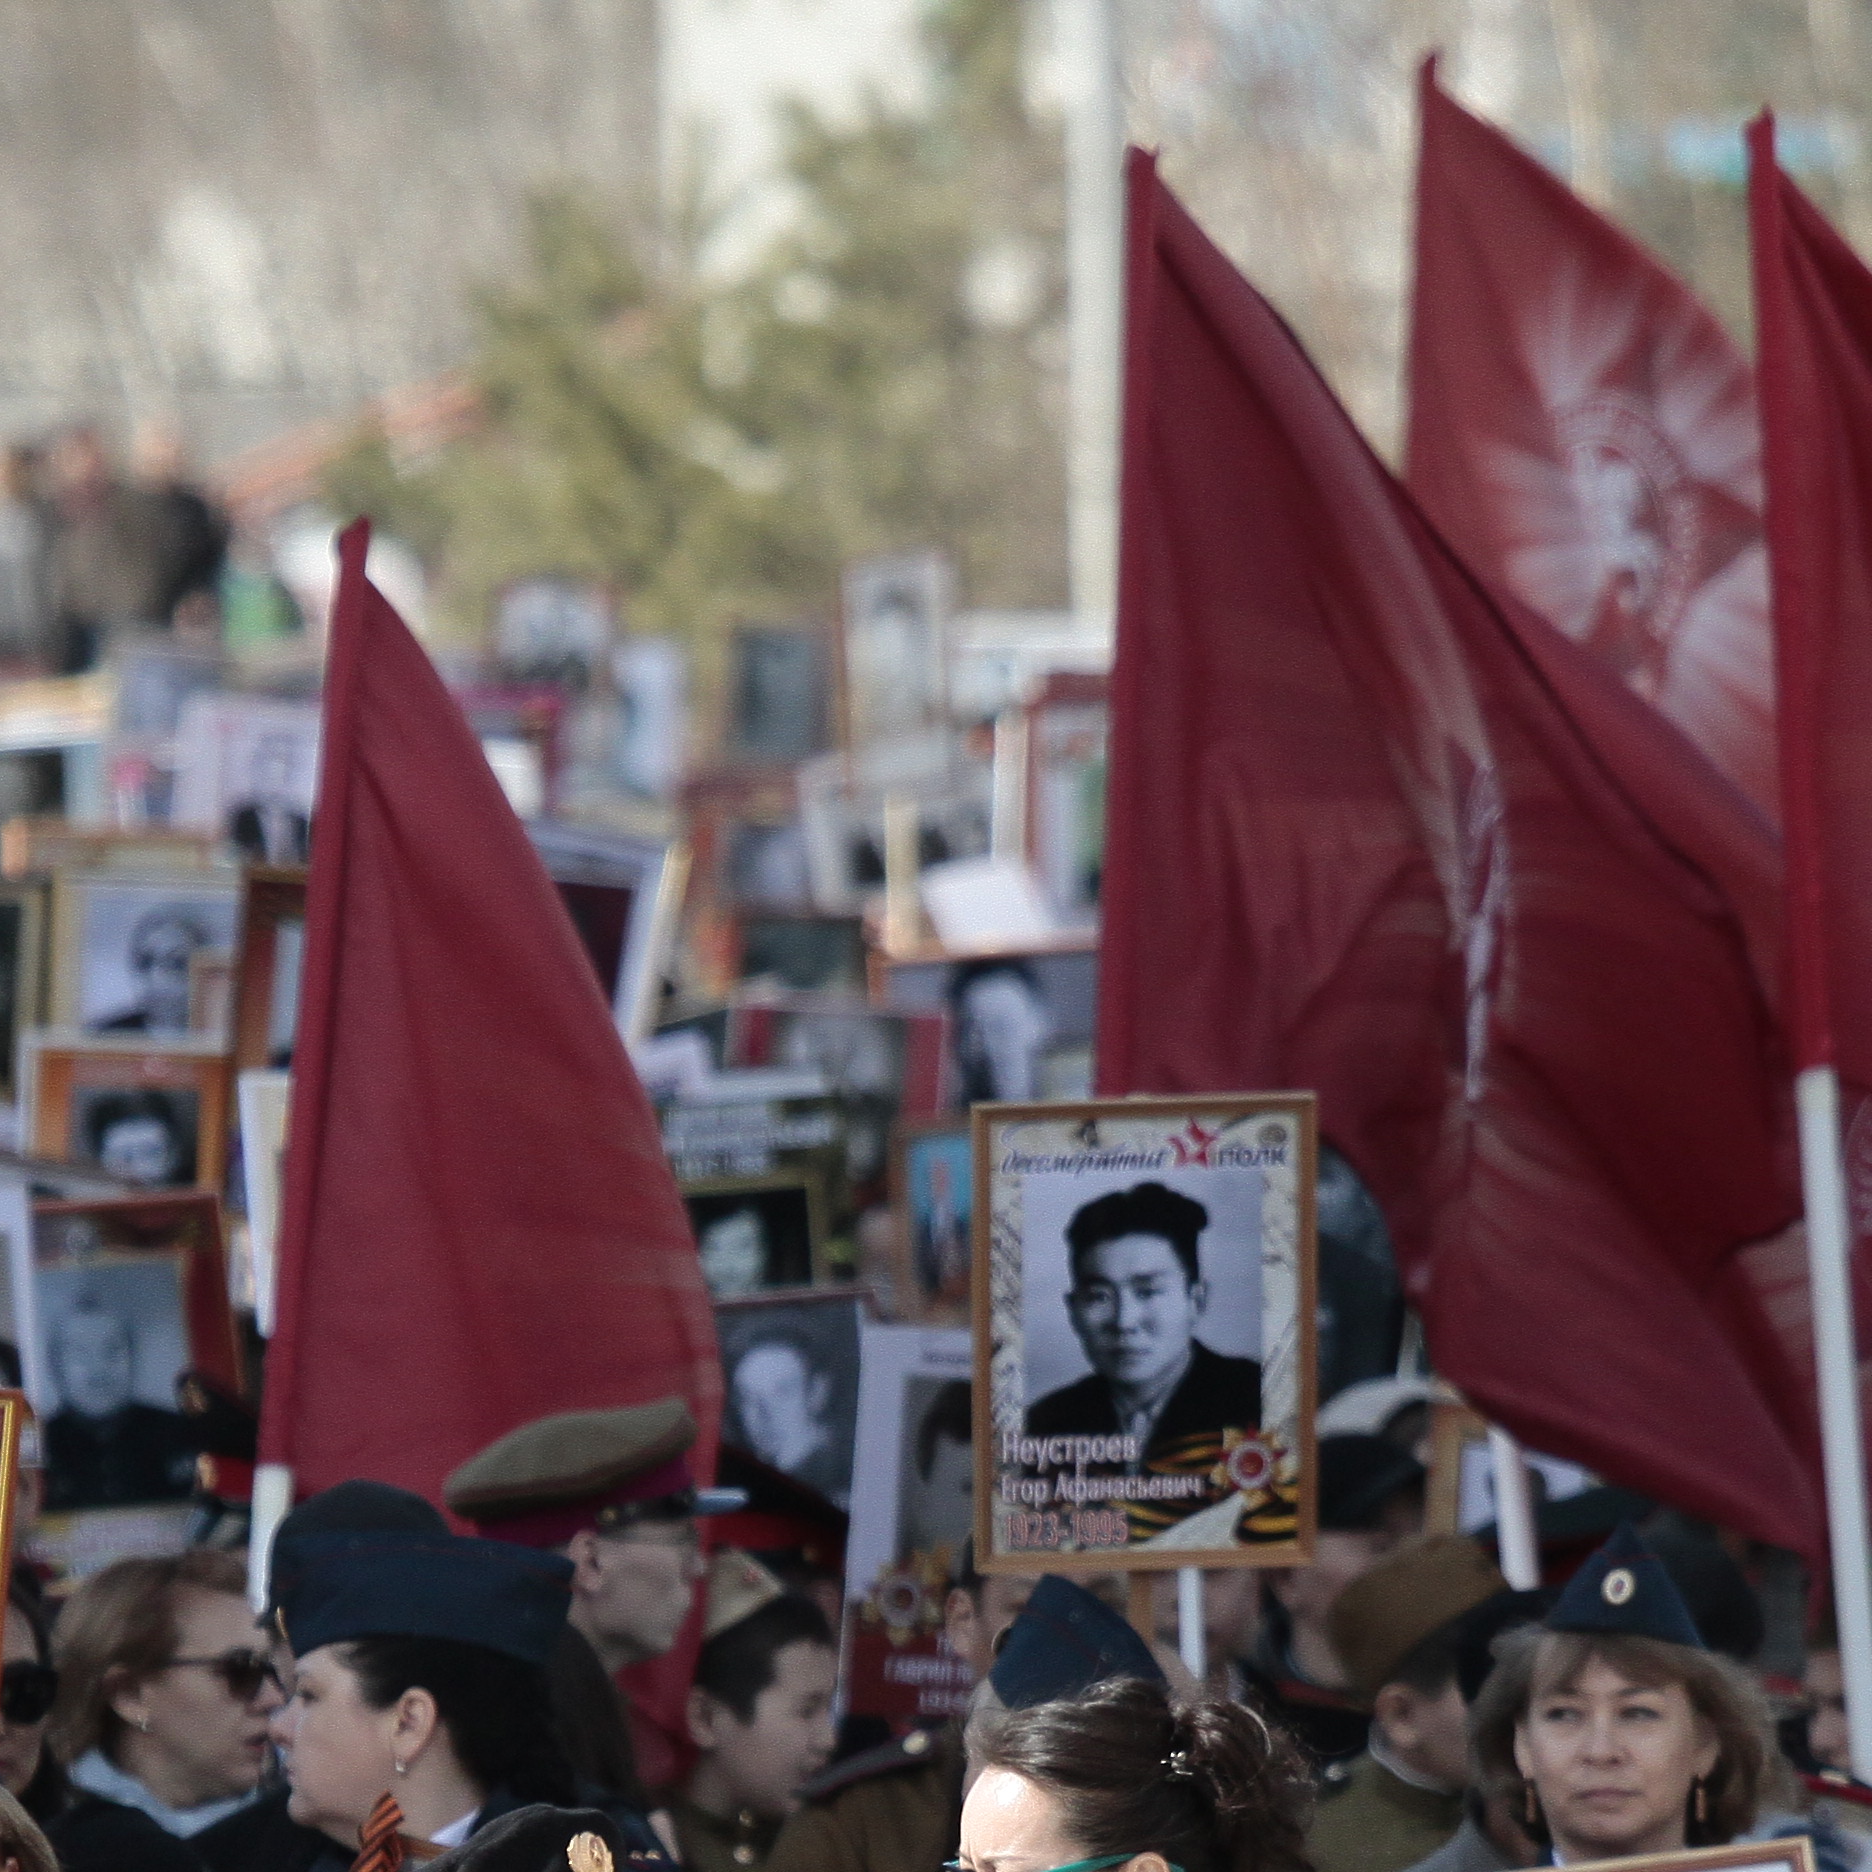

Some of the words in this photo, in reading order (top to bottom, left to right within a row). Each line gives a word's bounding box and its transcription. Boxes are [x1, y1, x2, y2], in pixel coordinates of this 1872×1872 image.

[1002, 1432, 1141, 1476] Неустроев
[1001, 1474, 1052, 1508] Егор
[1054, 1471, 1205, 1506] Афанасьевич
[1006, 1510, 1128, 1547] 1923-1995
